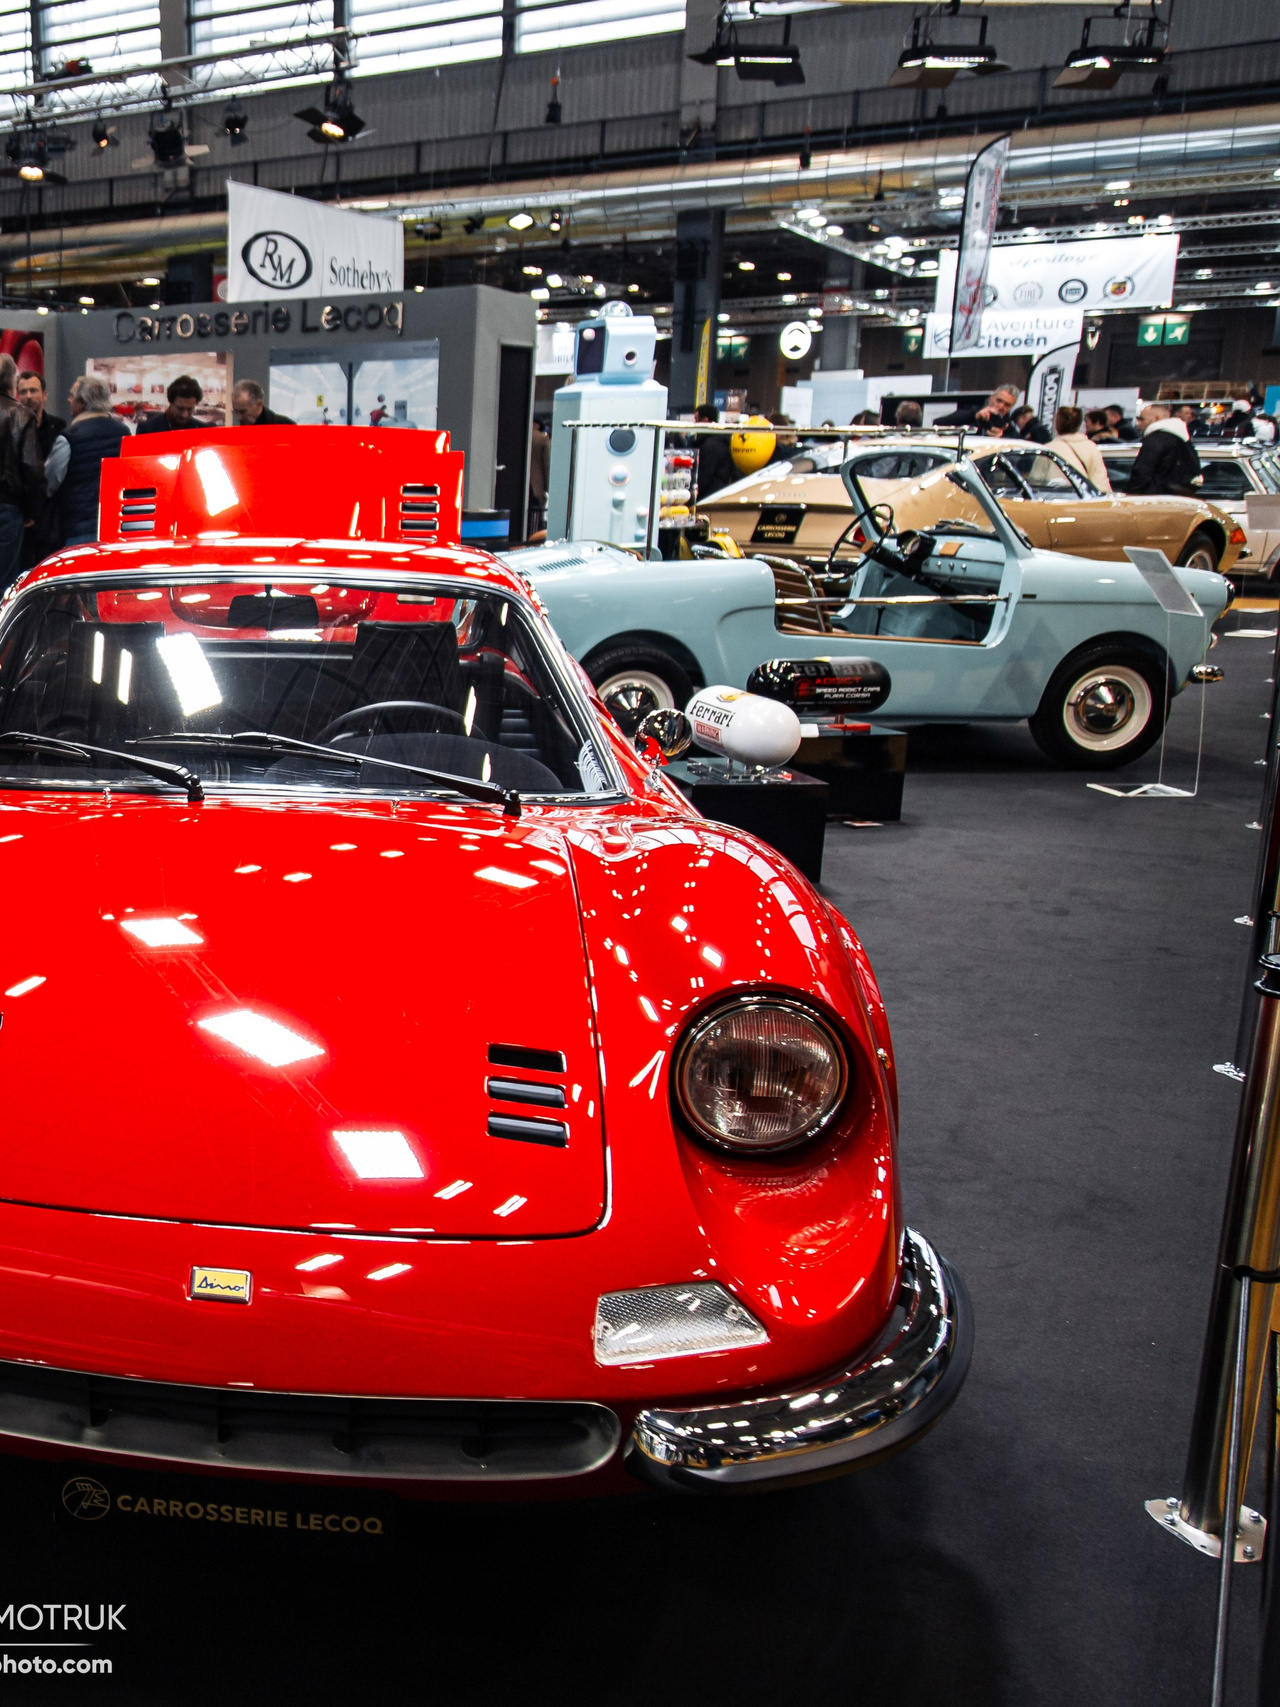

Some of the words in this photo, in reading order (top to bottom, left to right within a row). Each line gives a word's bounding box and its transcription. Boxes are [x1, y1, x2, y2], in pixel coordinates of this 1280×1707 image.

[259, 236, 296, 284] RM
[329, 256, 393, 291] Sotheby's
[114, 301, 291, 344] Carrosserie
[301, 299, 404, 336] Lecoq
[986, 317, 1075, 331] Aventure
[792, 662, 877, 676] Ferrari
[815, 676, 862, 685] ADDICT
[689, 699, 736, 728] Ferrari
[196, 1275, 245, 1292] Dino
[116, 1493, 288, 1529] CARROSSERIE
[295, 1512, 385, 1536] LECOQ
